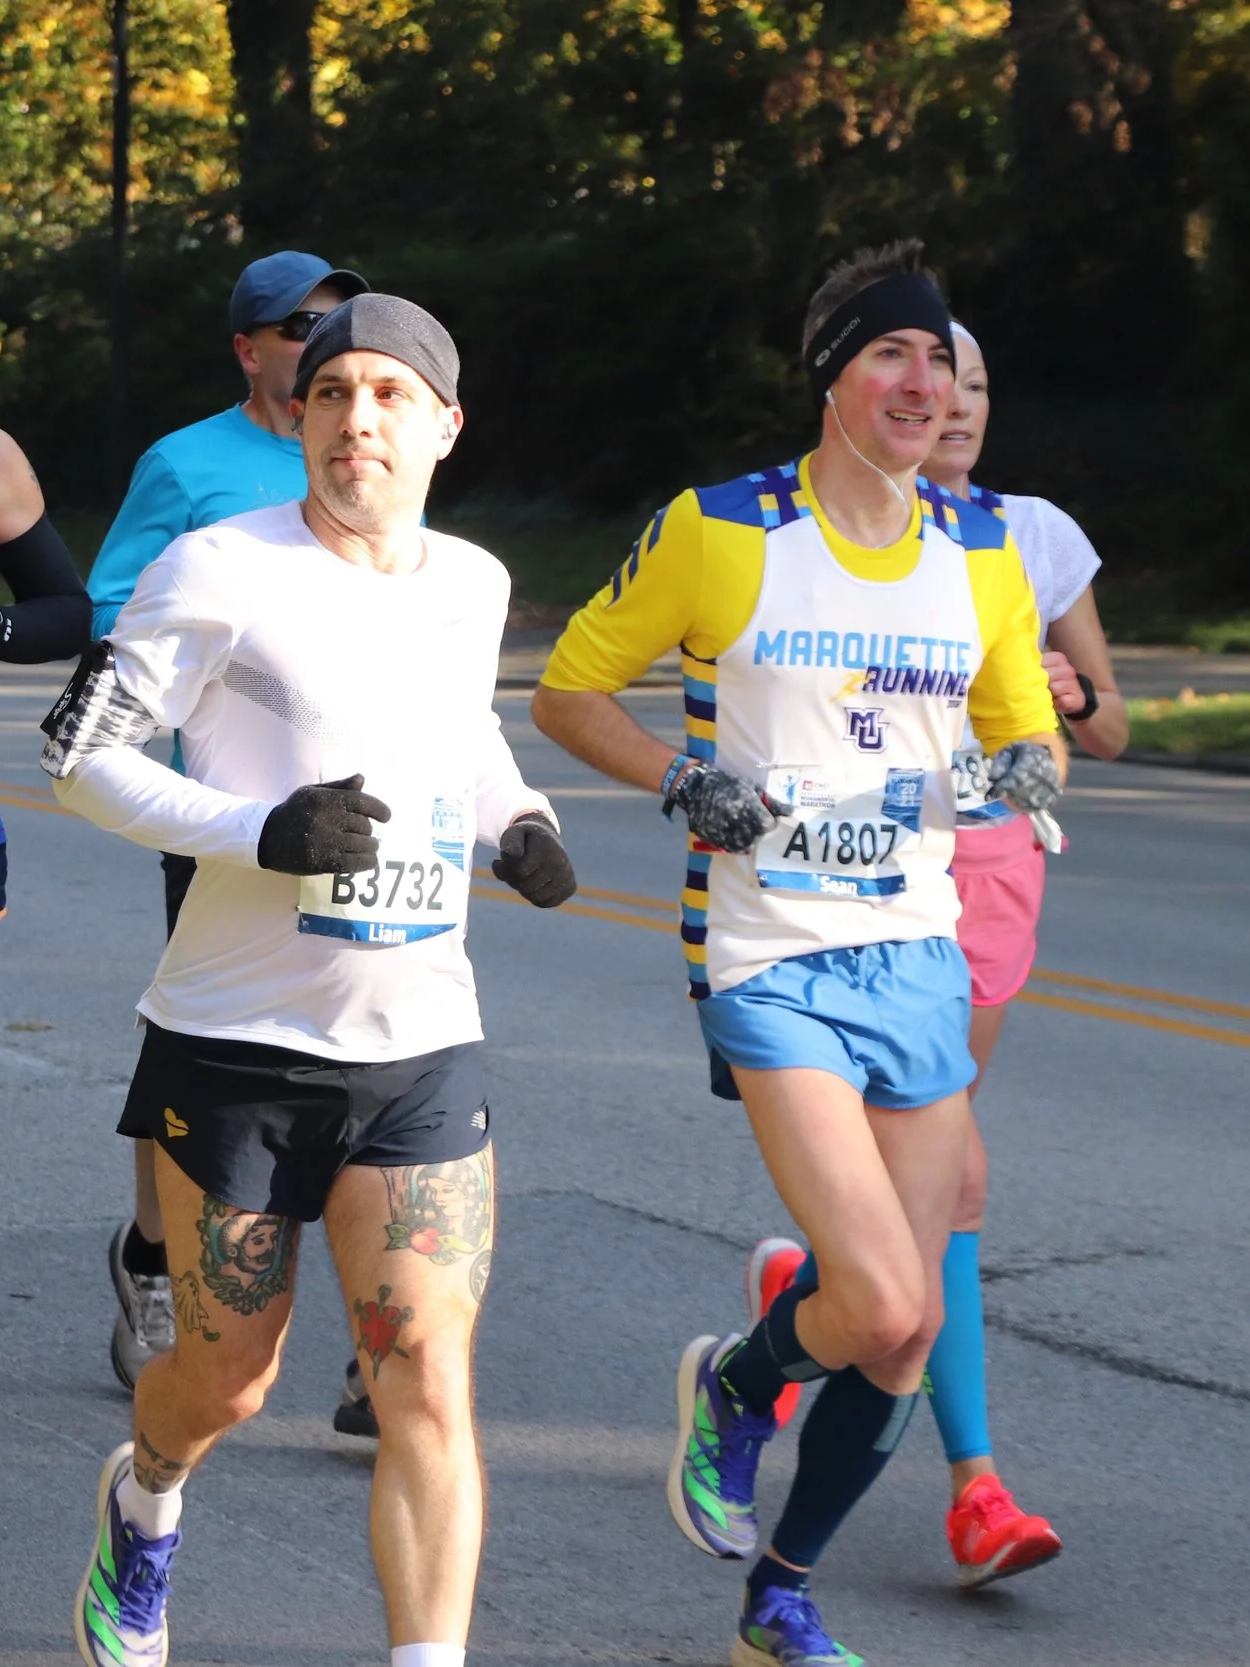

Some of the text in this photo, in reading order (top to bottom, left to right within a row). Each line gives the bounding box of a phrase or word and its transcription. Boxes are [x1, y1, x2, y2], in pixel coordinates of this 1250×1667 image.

[753, 629, 971, 676] MARQUETTE
[900, 782, 917, 795] 20
[782, 821, 898, 866] A1807
[331, 860, 443, 911] B3732
[368, 922, 407, 945] Liam
